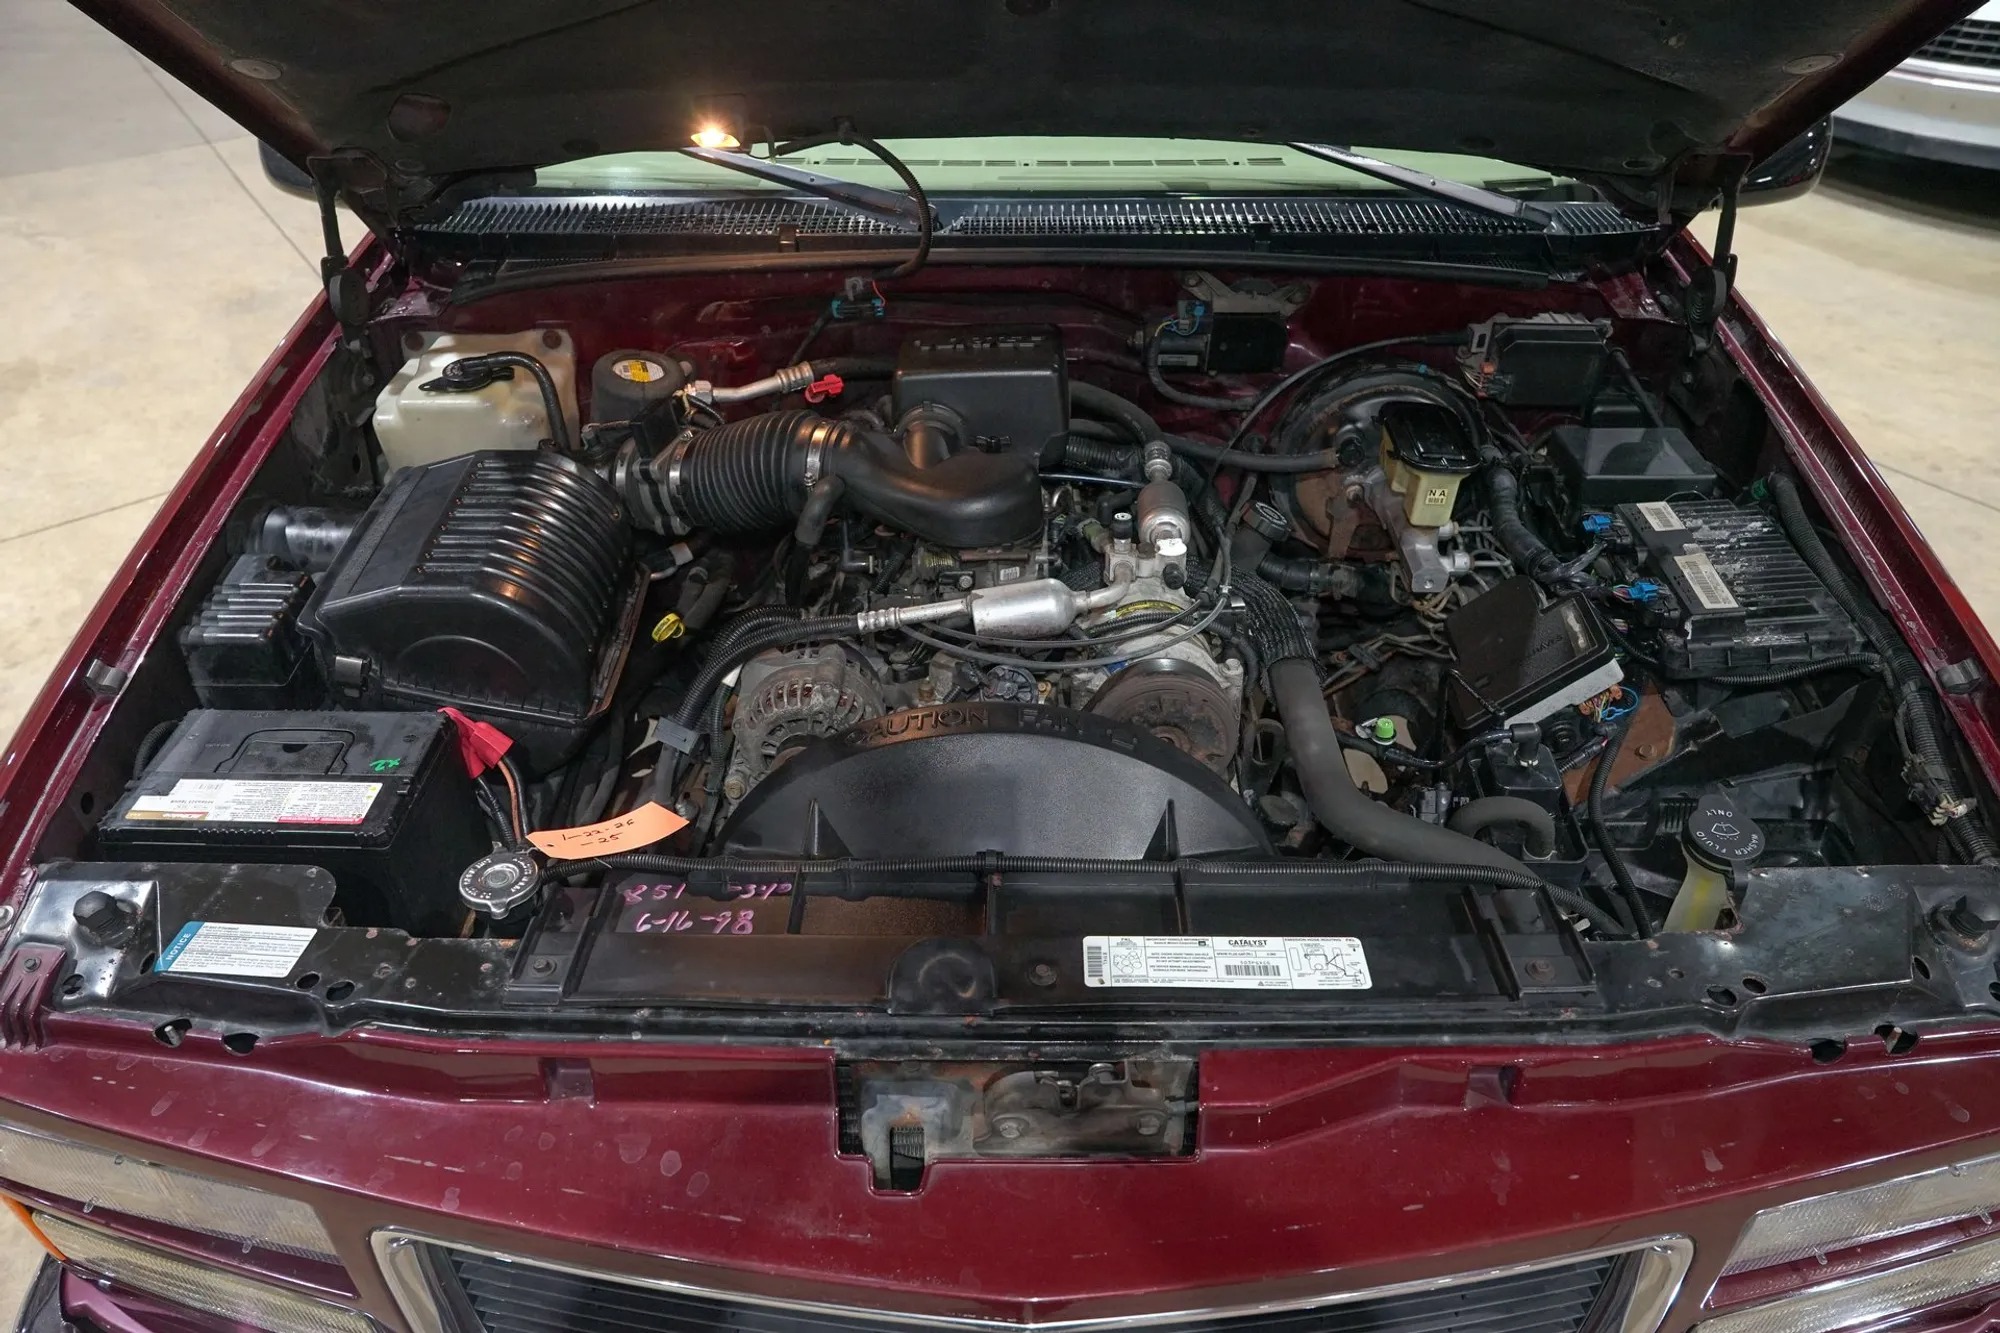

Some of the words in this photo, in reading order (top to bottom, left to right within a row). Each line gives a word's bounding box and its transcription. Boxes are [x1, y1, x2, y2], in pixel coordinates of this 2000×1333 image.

[845, 708, 990, 745] CAUTION
[1706, 809, 1733, 818] ONLY
[1696, 831, 1727, 854] FLUID
[1735, 833, 1759, 856] WASHER
[165, 932, 192, 961] NOTICE
